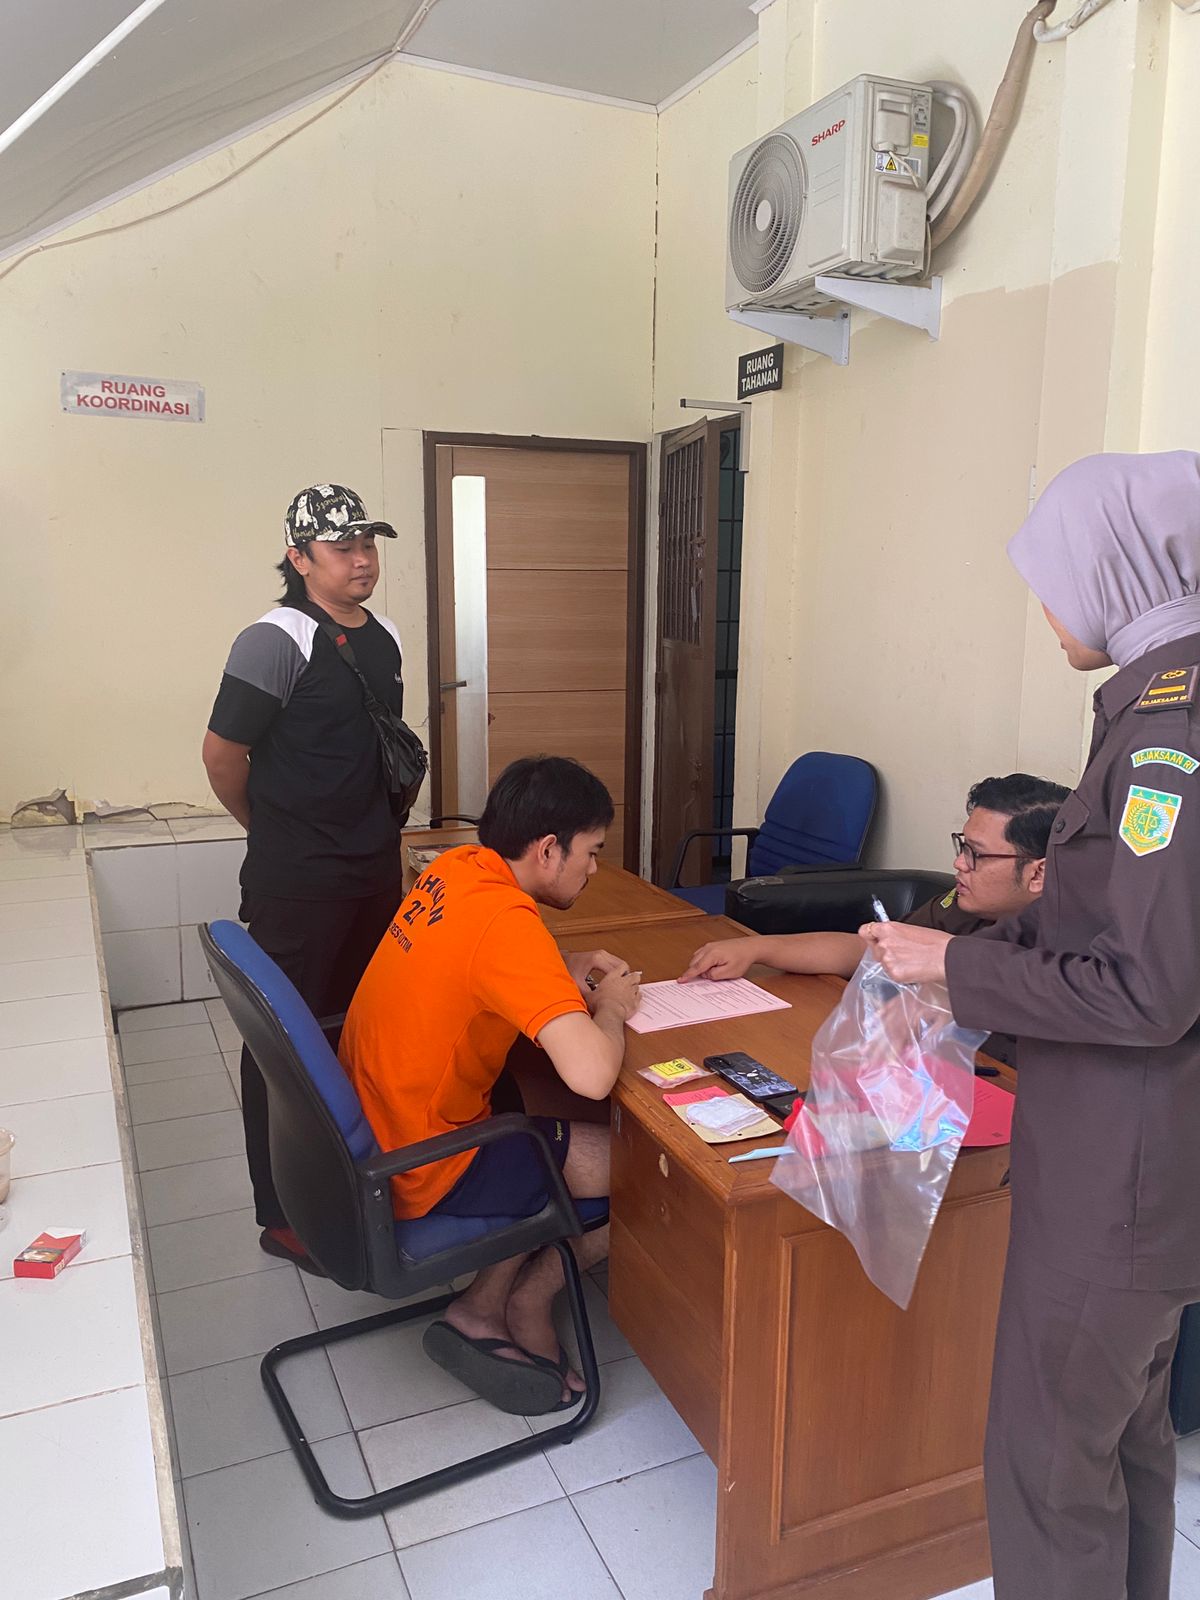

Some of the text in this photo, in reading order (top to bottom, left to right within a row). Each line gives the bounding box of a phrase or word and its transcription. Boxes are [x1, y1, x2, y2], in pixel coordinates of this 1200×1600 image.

[811, 119, 846, 147] SHARP
[745, 352, 774, 375] RUANG
[101, 380, 166, 398] RUANG
[741, 367, 779, 392] TAHANAN
[76, 393, 190, 415] KOORDINASI
[1135, 749, 1195, 770] KEJAKSAAN RI
